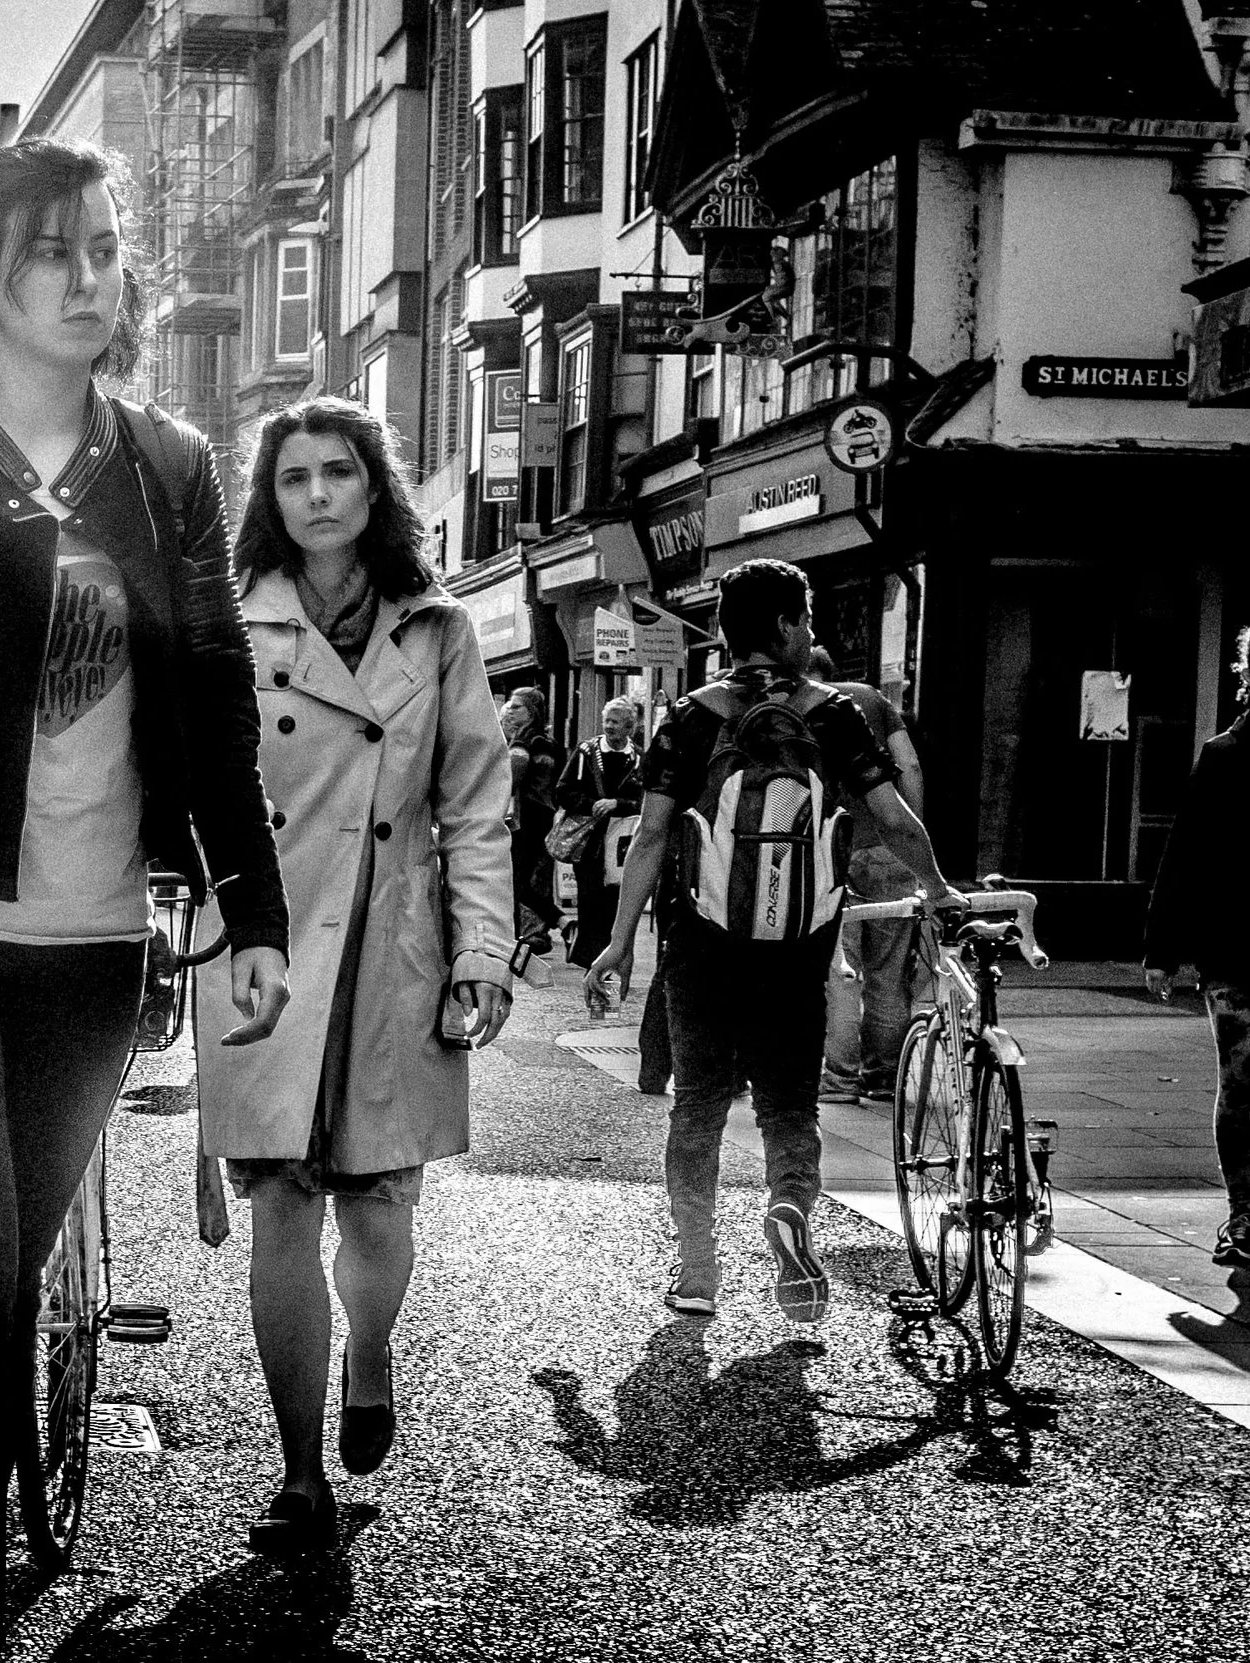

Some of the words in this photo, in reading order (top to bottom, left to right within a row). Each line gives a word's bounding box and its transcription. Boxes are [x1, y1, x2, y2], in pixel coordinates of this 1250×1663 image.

[1038, 366, 1066, 384] ST
[1071, 366, 1188, 387] MICHAEL'S
[491, 485, 510, 497] 020
[596, 628, 630, 639] PHONE
[766, 868, 780, 928] CONVERSE
